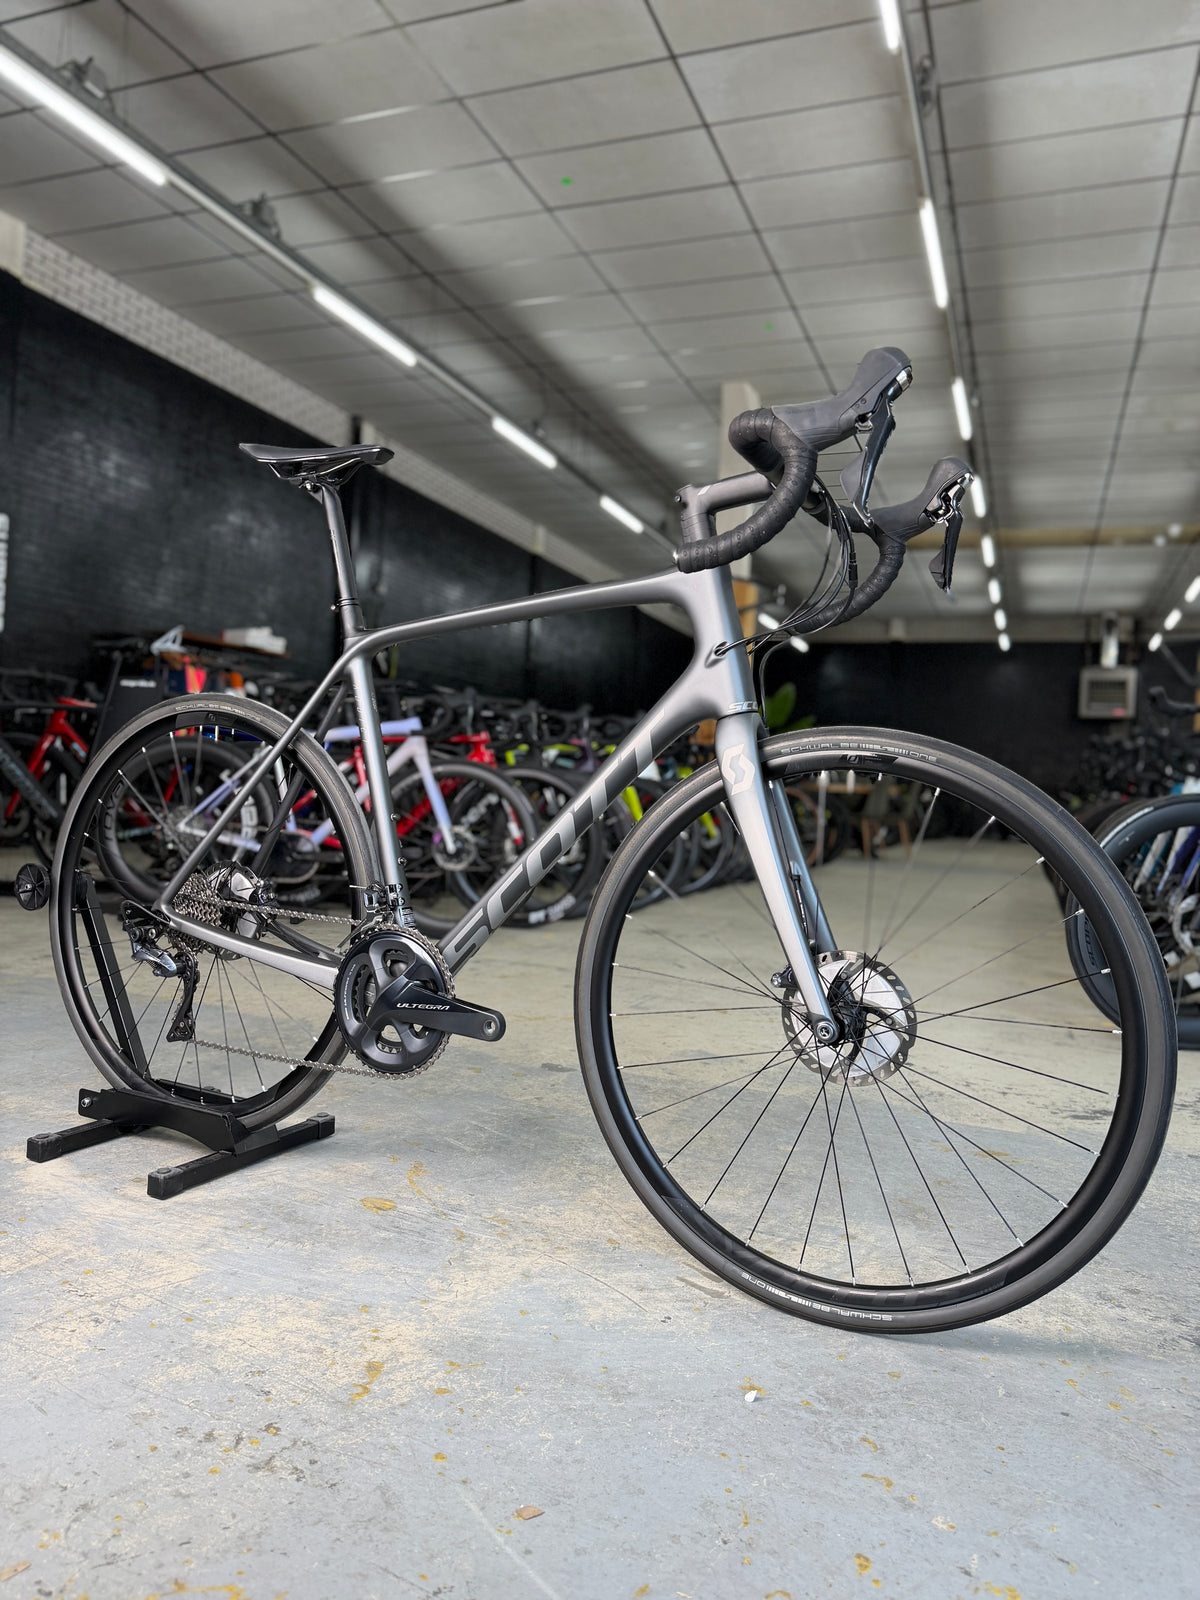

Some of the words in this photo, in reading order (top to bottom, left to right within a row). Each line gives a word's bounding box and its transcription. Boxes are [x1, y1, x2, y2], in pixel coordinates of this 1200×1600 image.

[781, 742, 859, 755] SCHWALBE
[909, 751, 938, 763] ONE
[442, 708, 664, 978] SCOTT
[397, 1002, 450, 1011] ULTEGRA
[741, 1271, 766, 1288] ONE
[812, 1303, 893, 1322] SCHWALBE
